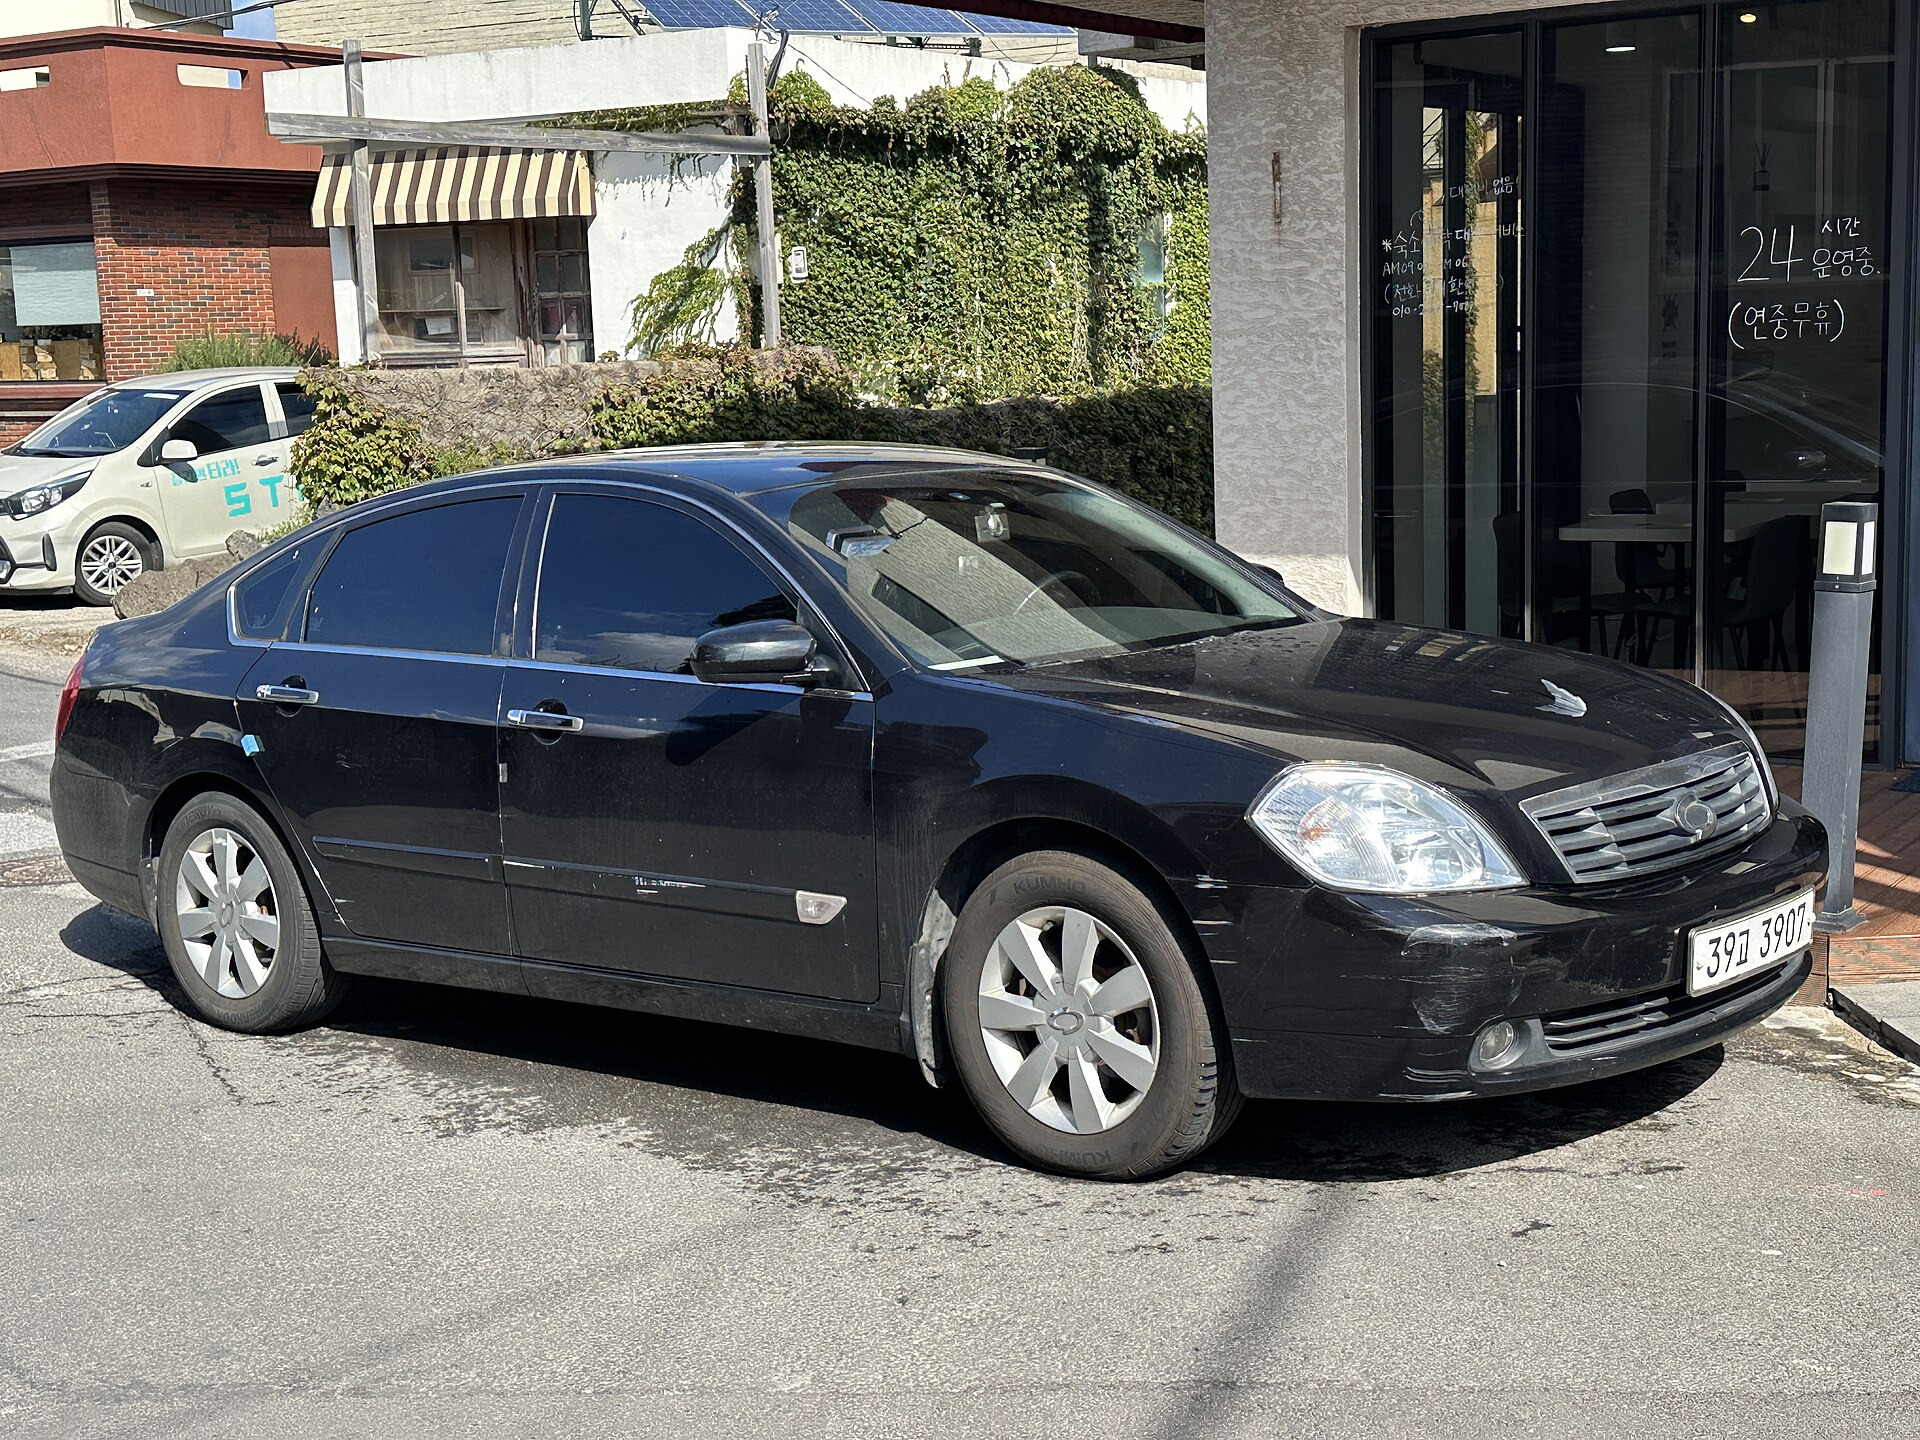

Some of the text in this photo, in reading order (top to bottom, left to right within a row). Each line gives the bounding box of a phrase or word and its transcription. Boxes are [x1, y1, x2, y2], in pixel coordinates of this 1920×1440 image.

[1738, 217, 1860, 282] 24 시간
[1728, 299, 1845, 349] (연중무휴)
[1013, 875, 1088, 896] KUMHO
[1760, 902, 1806, 958] 3907
